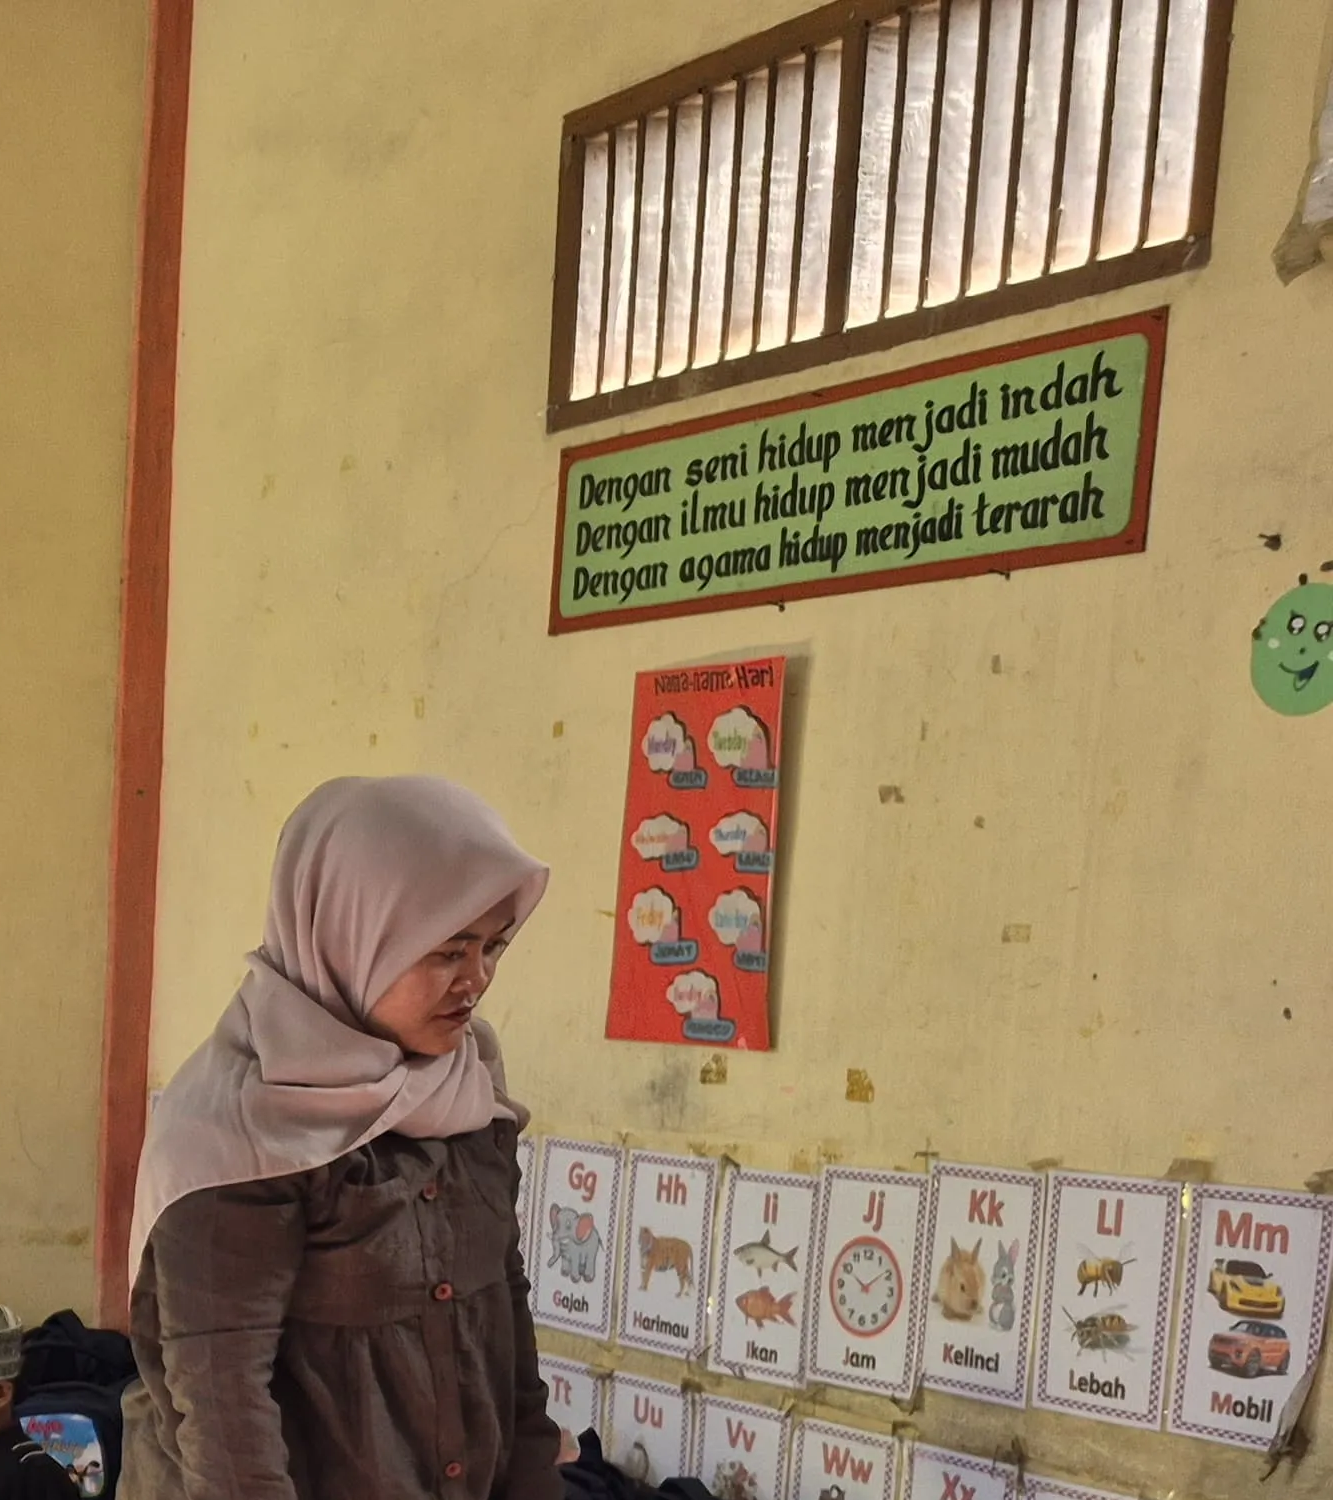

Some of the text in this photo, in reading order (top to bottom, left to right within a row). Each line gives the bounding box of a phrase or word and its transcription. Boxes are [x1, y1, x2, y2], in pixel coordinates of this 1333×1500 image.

[578, 352, 1122, 513] Dengan seni hidup menjadi indah
[576, 412, 1110, 557] Dengan ilmu hidup menjadi mudah
[573, 472, 1104, 602] Dengan agama hidup menjadi terarah
[735, 665, 774, 690] Hari
[568, 1161, 597, 1202] Gg
[656, 1173, 687, 1206] Hh
[862, 1190, 885, 1231] Jj
[968, 1188, 1005, 1227] Kk
[1096, 1198, 1124, 1236] Ll
[1215, 1209, 1289, 1255] Mm
[552, 1290, 589, 1313] Gajah
[633, 1310, 689, 1340] Harimau
[746, 1340, 779, 1365] Ikan
[842, 1346, 876, 1370] Jam
[942, 1342, 999, 1373] Kelinci
[552, 1375, 571, 1405] Tt
[1068, 1368, 1126, 1401] Lebah
[633, 1396, 663, 1429] Uu
[1210, 1391, 1273, 1423] Mobil
[726, 1417, 756, 1452] Vv
[822, 1442, 873, 1484] Ww
